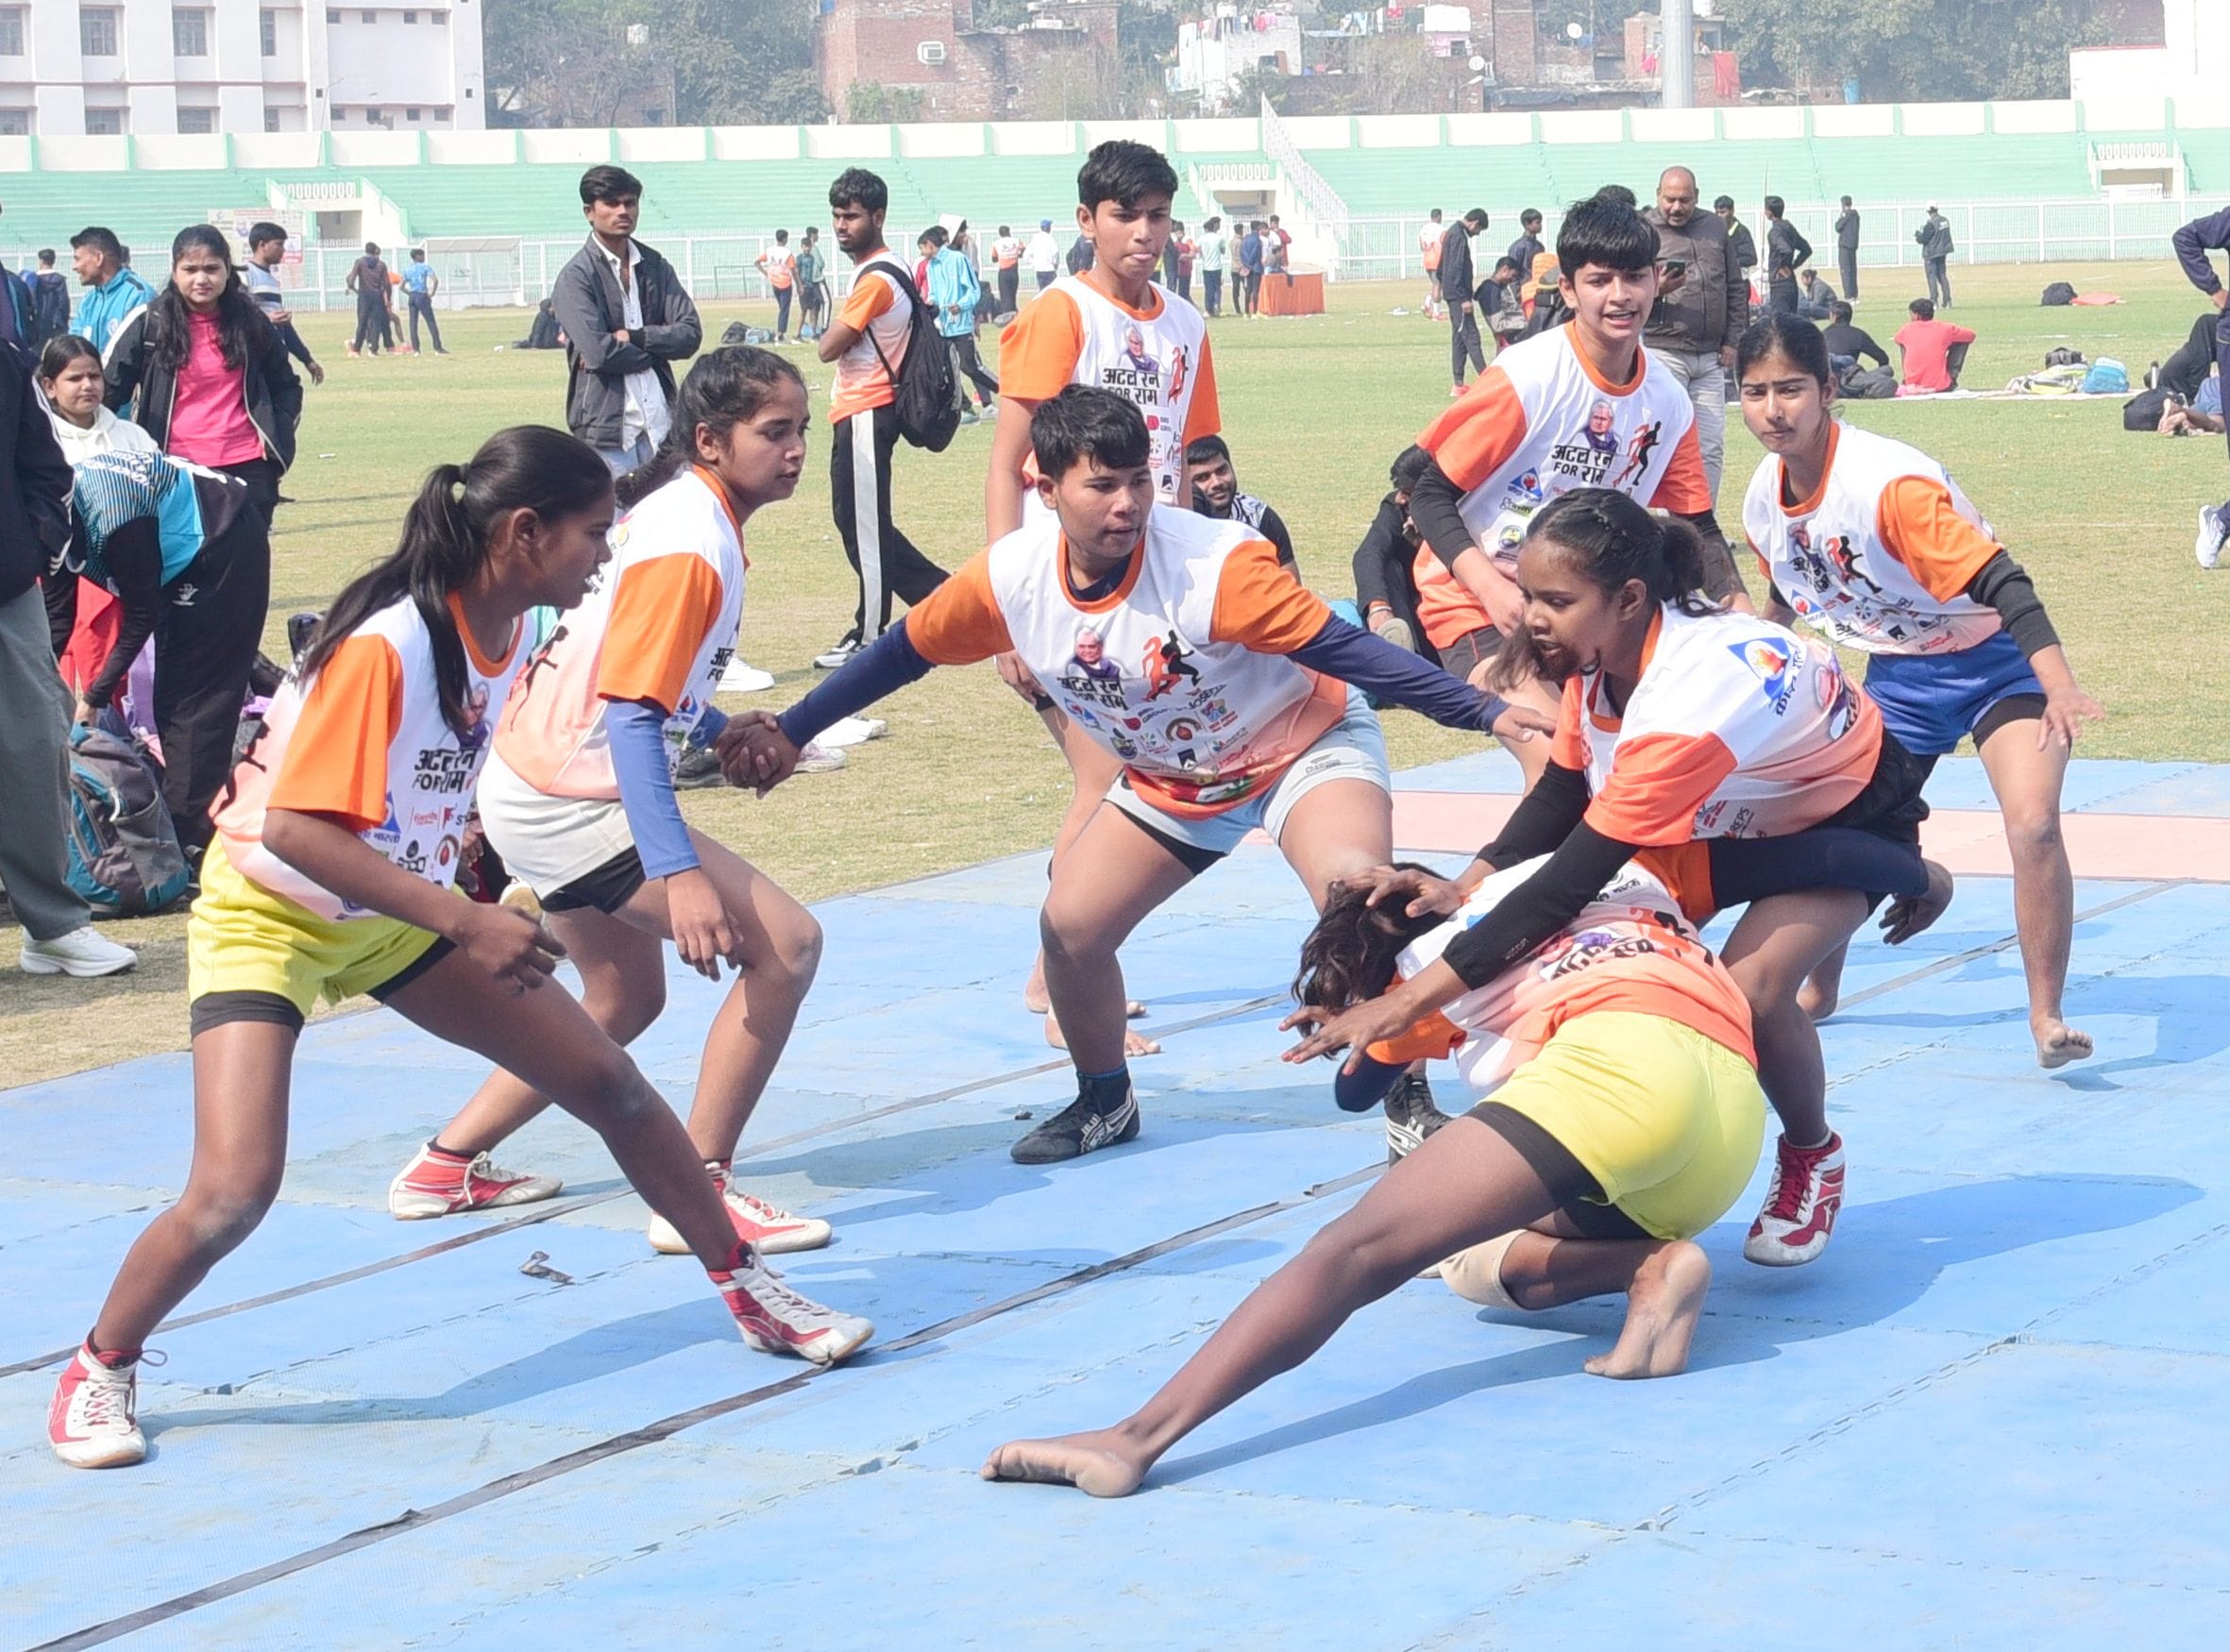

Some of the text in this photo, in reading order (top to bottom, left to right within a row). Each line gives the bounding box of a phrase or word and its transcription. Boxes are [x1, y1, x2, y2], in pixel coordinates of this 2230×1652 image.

[1103, 368, 1159, 388] अटल रन
[1133, 387, 1157, 406] राम
[1551, 445, 1614, 469] अटल रन
[1553, 462, 1606, 485] FOR राम
[1730, 806, 1751, 832] REPS
